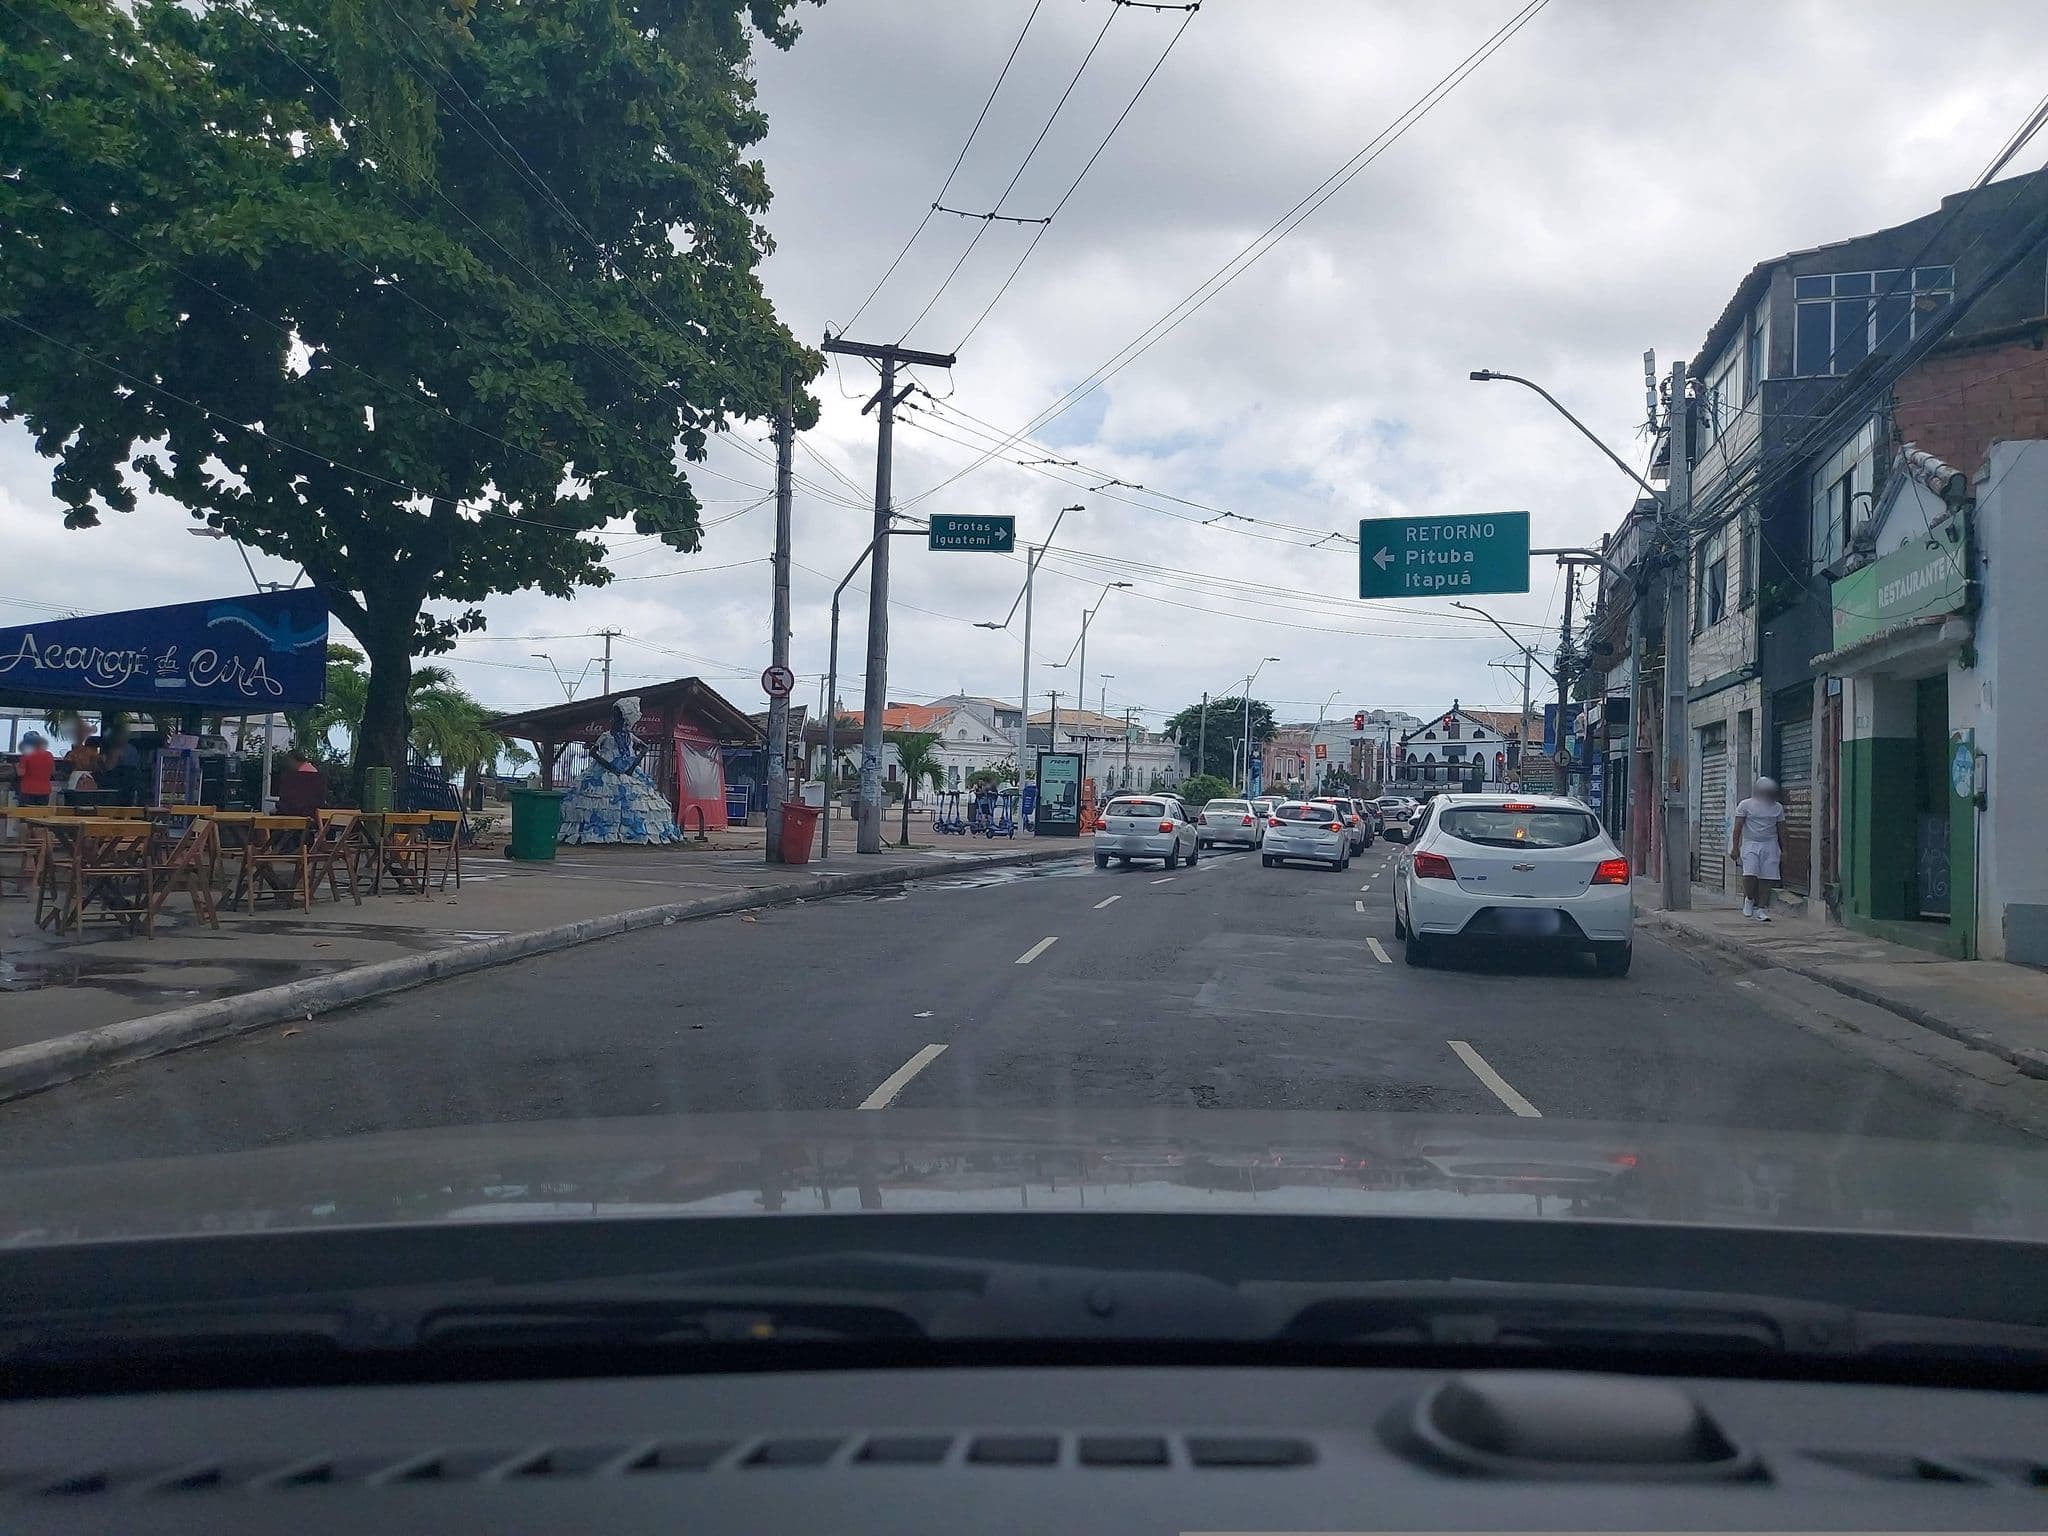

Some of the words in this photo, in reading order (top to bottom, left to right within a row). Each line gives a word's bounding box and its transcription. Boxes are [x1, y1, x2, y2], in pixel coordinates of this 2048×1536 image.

[948, 521, 991, 532] Brotas
[1406, 523, 1495, 542] RETORNO
[935, 534, 991, 546] Iguatemi
[1406, 548, 1474, 565] Pituba
[1878, 556, 1945, 609] RESTAURANTE
[154, 645, 180, 672] da
